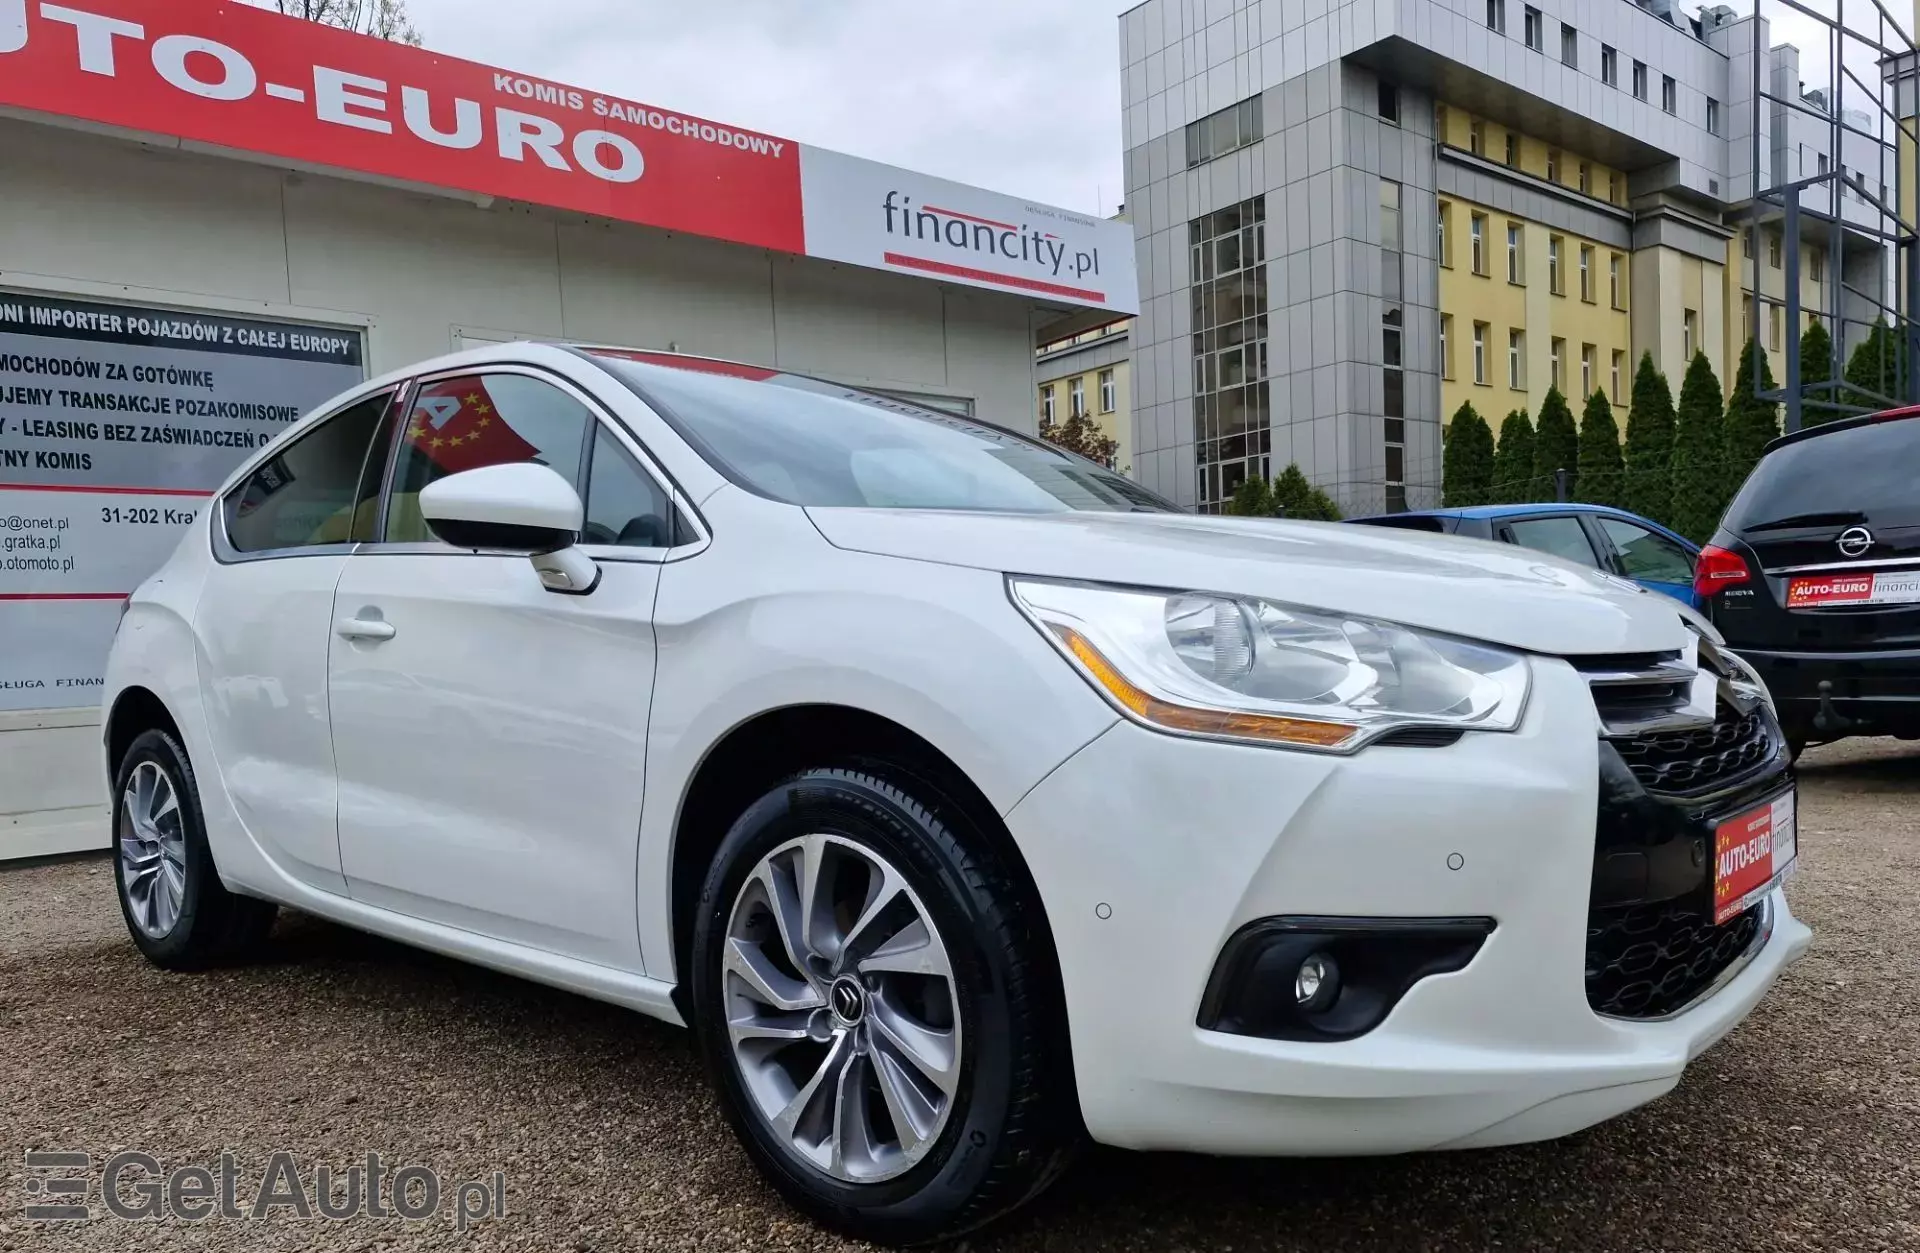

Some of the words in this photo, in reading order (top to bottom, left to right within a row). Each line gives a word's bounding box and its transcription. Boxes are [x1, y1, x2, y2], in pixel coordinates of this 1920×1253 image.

[493, 73, 584, 110] KOMIS
[592, 98, 784, 158] SAMOCHODOWY
[882, 190, 1099, 279] financity.pl
[0, 303, 23, 323] NI
[29, 306, 123, 333] IMPORTER
[127, 316, 218, 343] POJAZDÓW
[223, 327, 234, 344] Z
[237, 328, 286, 349] CAŁEJ
[290, 334, 350, 355] EUROPY
[105, 363, 128, 381] ZA
[132, 364, 214, 392] GOTÓWKĘ
[0, 386, 53, 406] JEMY
[58, 390, 171, 415] TRANSAKCJE
[175, 399, 299, 422] POZAKOMISOWE
[22, 418, 99, 440] LEASING
[103, 423, 137, 442] BEZ
[141, 424, 254, 448] ZAŚWIADCZEŃ
[0, 449, 29, 468] NY
[35, 450, 92, 471] KOMIS
[101, 507, 160, 524] 31-202
[164, 509, 198, 525] Kra
[0, 555, 74, 574] .otomoto.pl
[1796, 582, 1868, 596] AUTO-EURO
[0, 680, 45, 689] ŁUGA
[1718, 831, 1771, 880] AUTO-EURO
